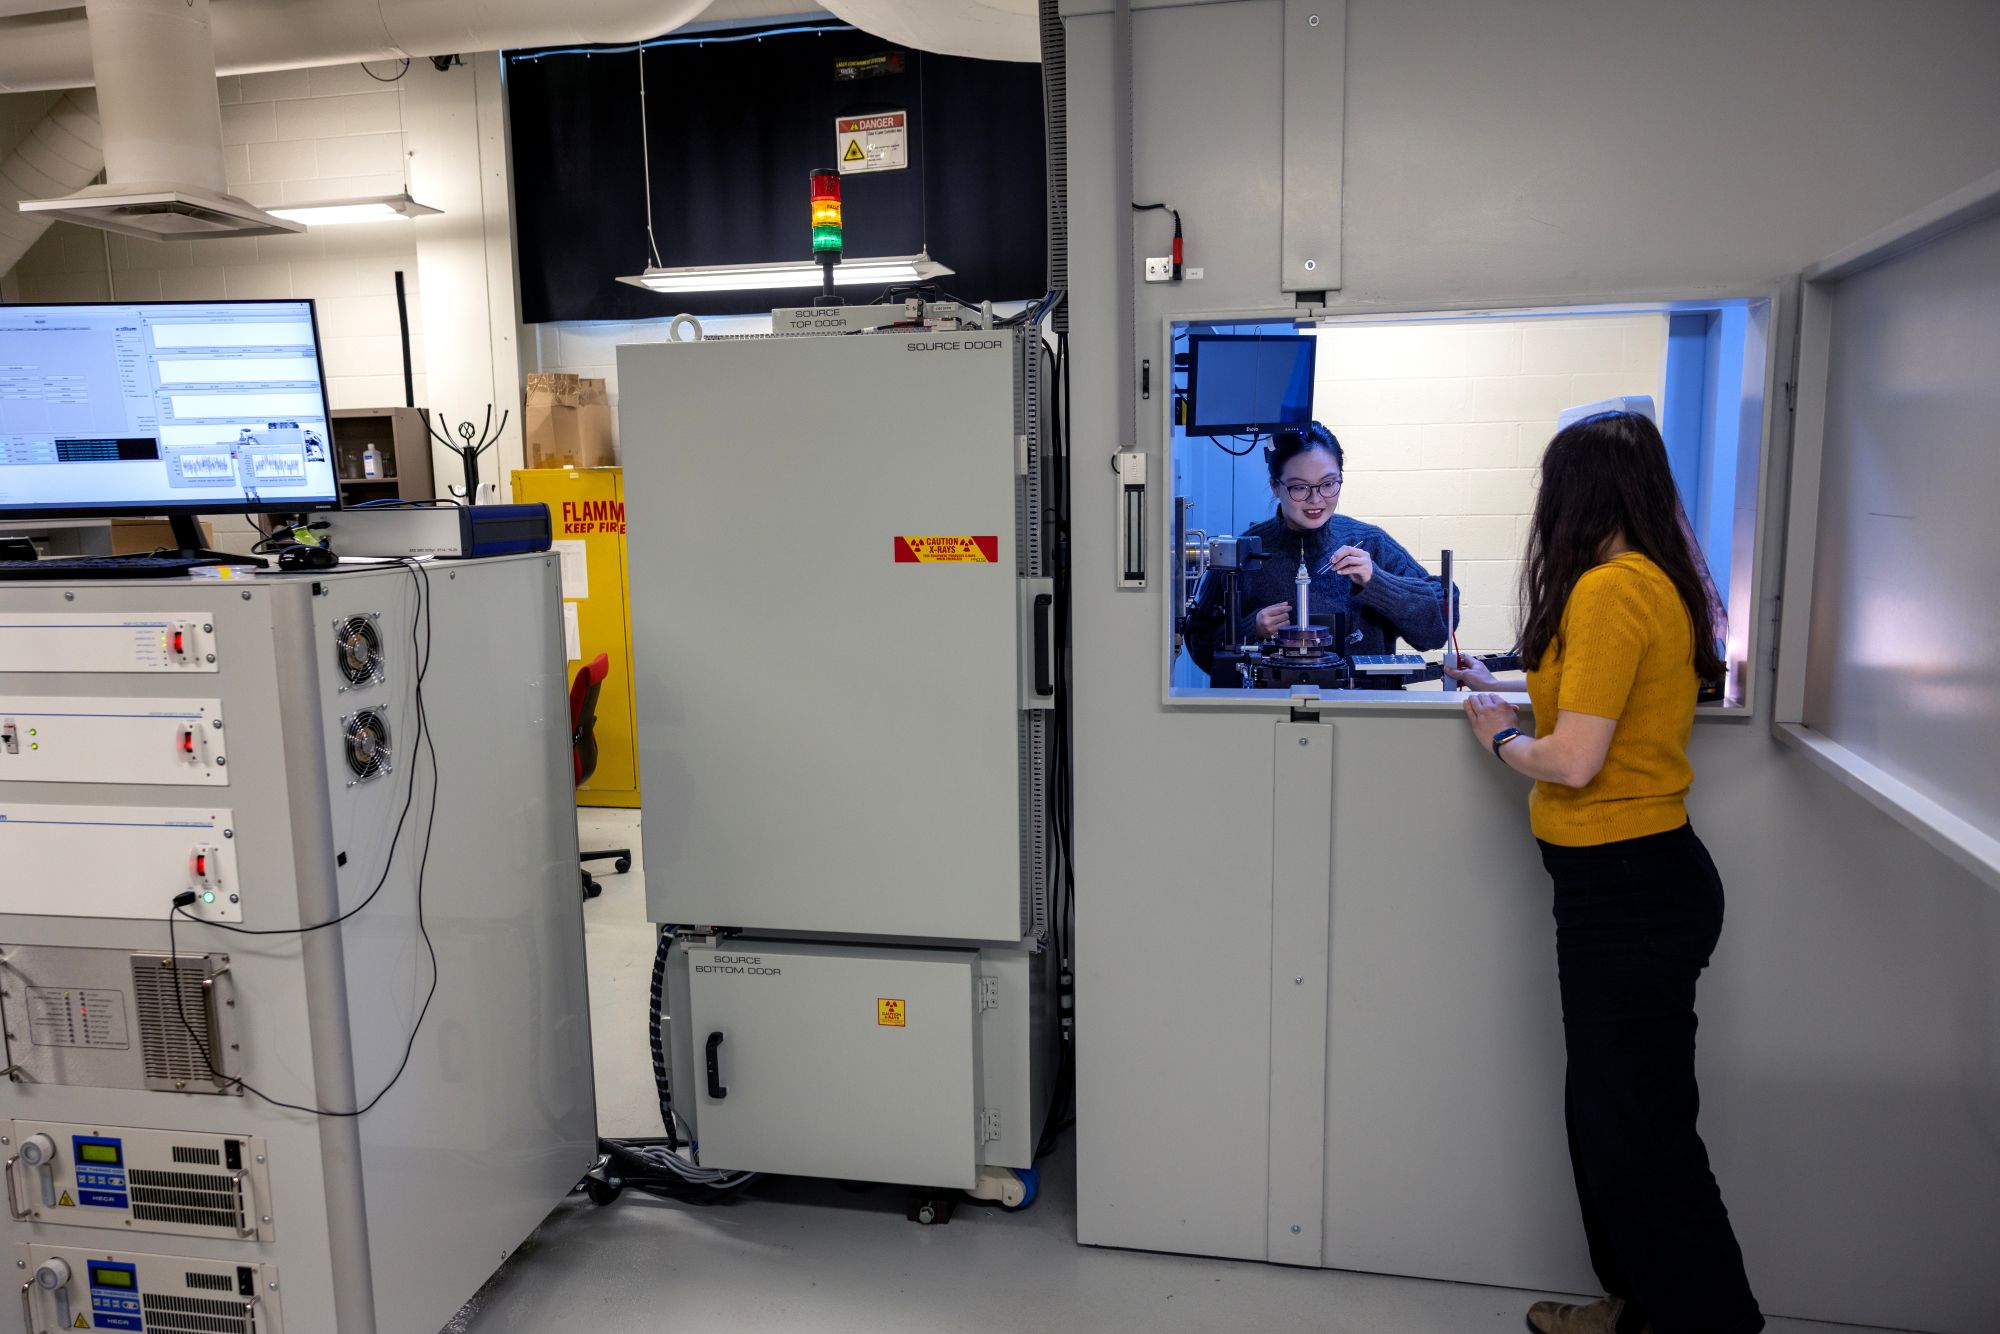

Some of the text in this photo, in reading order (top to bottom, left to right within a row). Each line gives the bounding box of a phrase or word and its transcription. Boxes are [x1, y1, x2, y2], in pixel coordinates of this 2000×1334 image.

[860, 117, 894, 130] DANGER
[795, 308, 840, 318] SOURCE
[790, 319, 847, 329] TOP DOOR
[907, 340, 1002, 352] SOURCE DOOR
[564, 521, 626, 535] KEEP FIRE
[714, 955, 761, 965] SOURCE
[695, 965, 781, 976] BOTTOM DOOR
